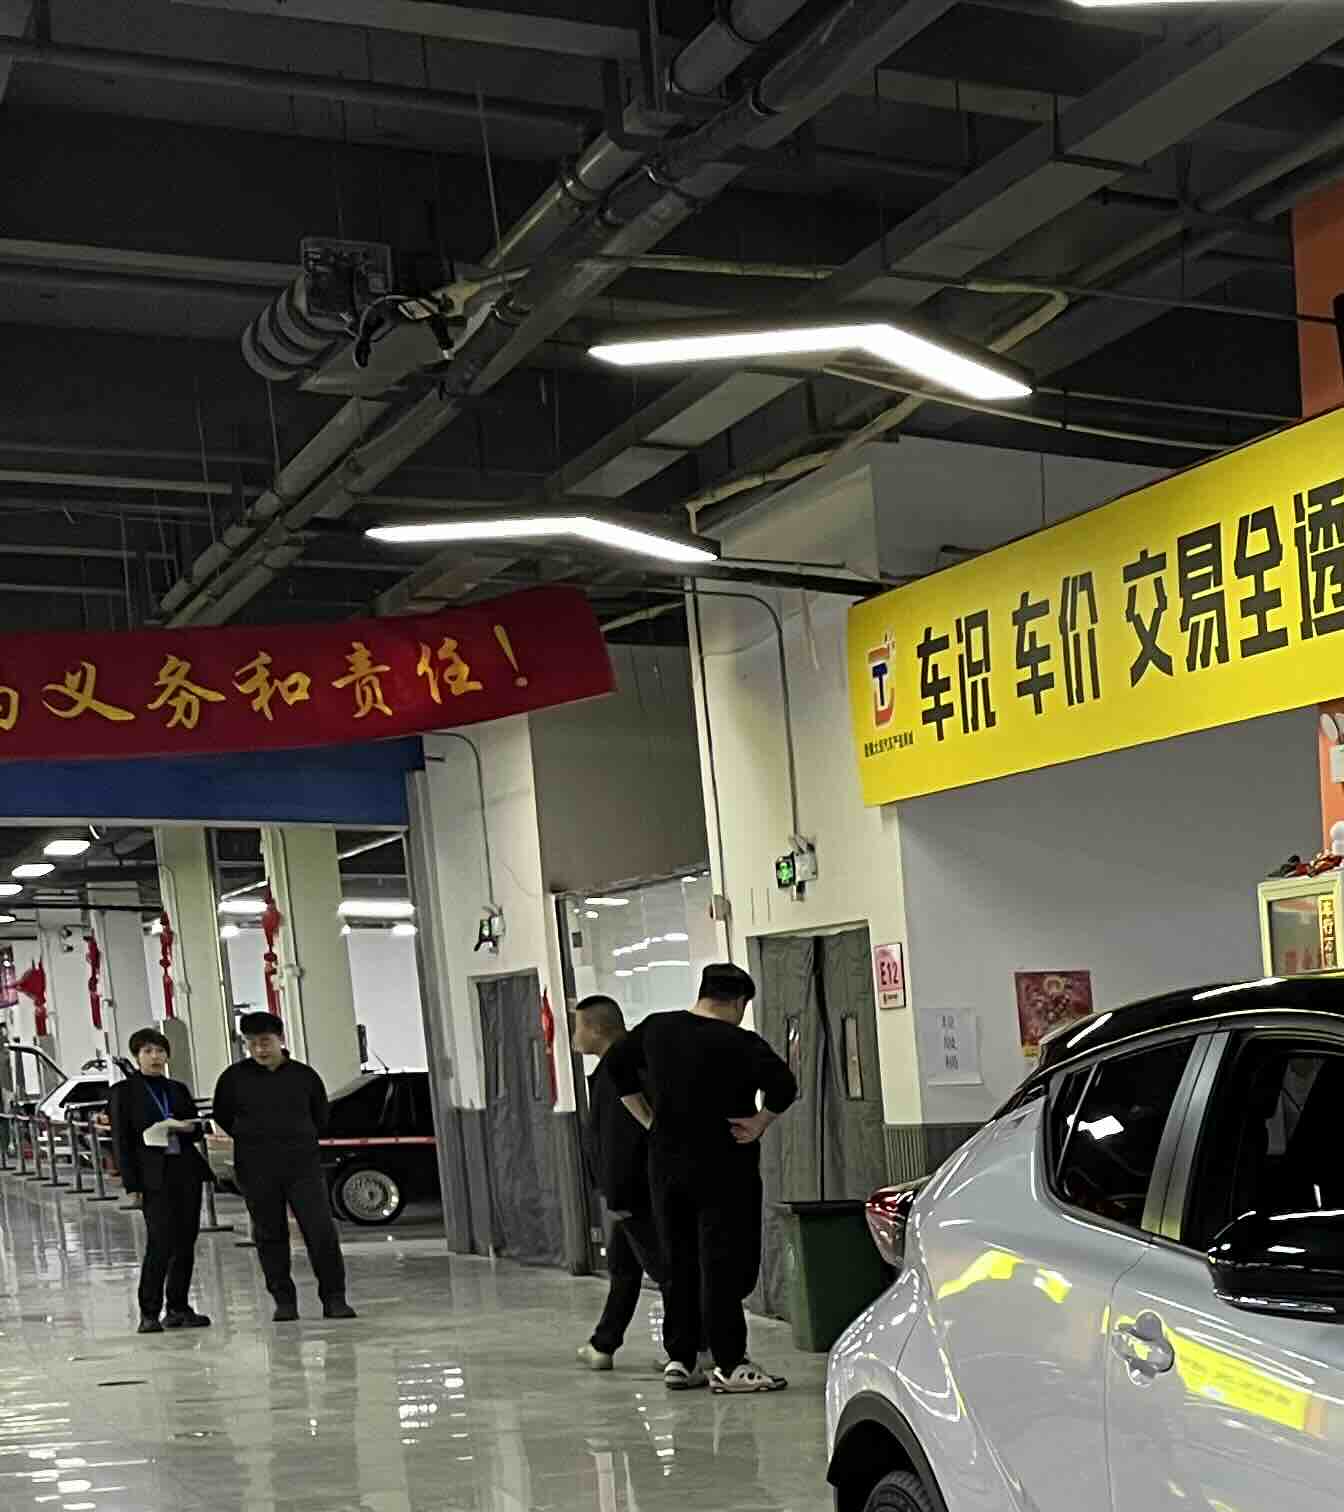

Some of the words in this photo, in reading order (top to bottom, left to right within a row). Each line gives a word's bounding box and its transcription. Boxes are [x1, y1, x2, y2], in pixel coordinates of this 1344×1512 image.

[0, 624, 529, 731] 义务和责任！
[916, 610, 996, 742] 车况
[1012, 571, 1100, 716] 车价
[880, 961, 899, 985] E12
